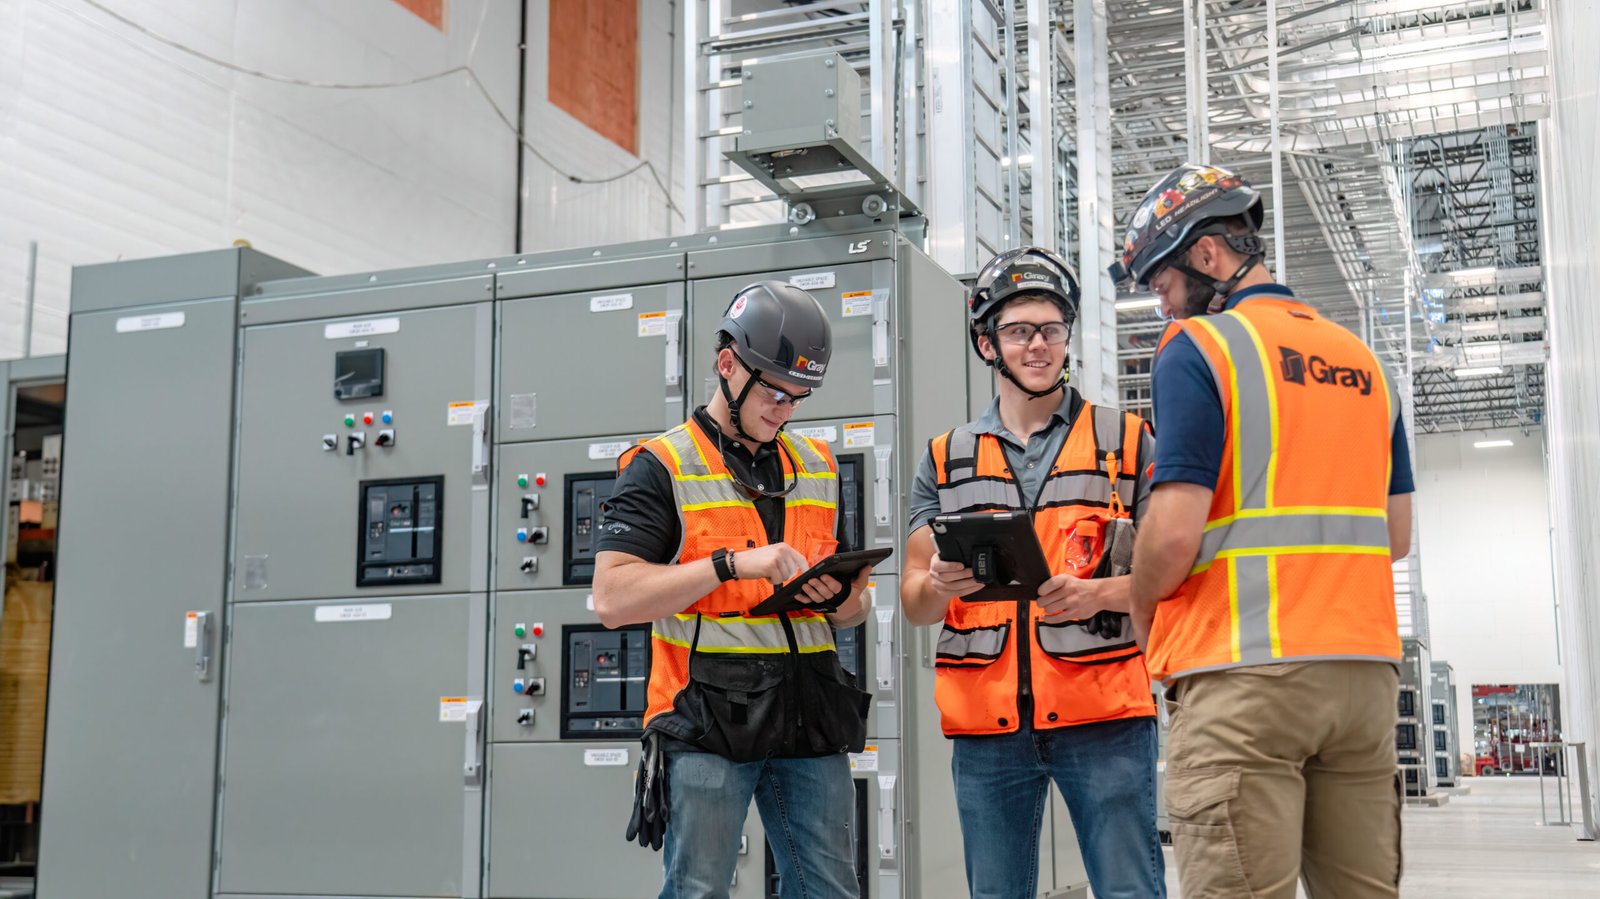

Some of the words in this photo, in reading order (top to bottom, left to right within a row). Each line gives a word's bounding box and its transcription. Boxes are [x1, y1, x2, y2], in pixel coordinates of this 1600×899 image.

[1155, 215, 1173, 230] LED
[848, 240, 872, 254] LS
[1023, 271, 1050, 282] Gray
[1308, 355, 1372, 396] Gray
